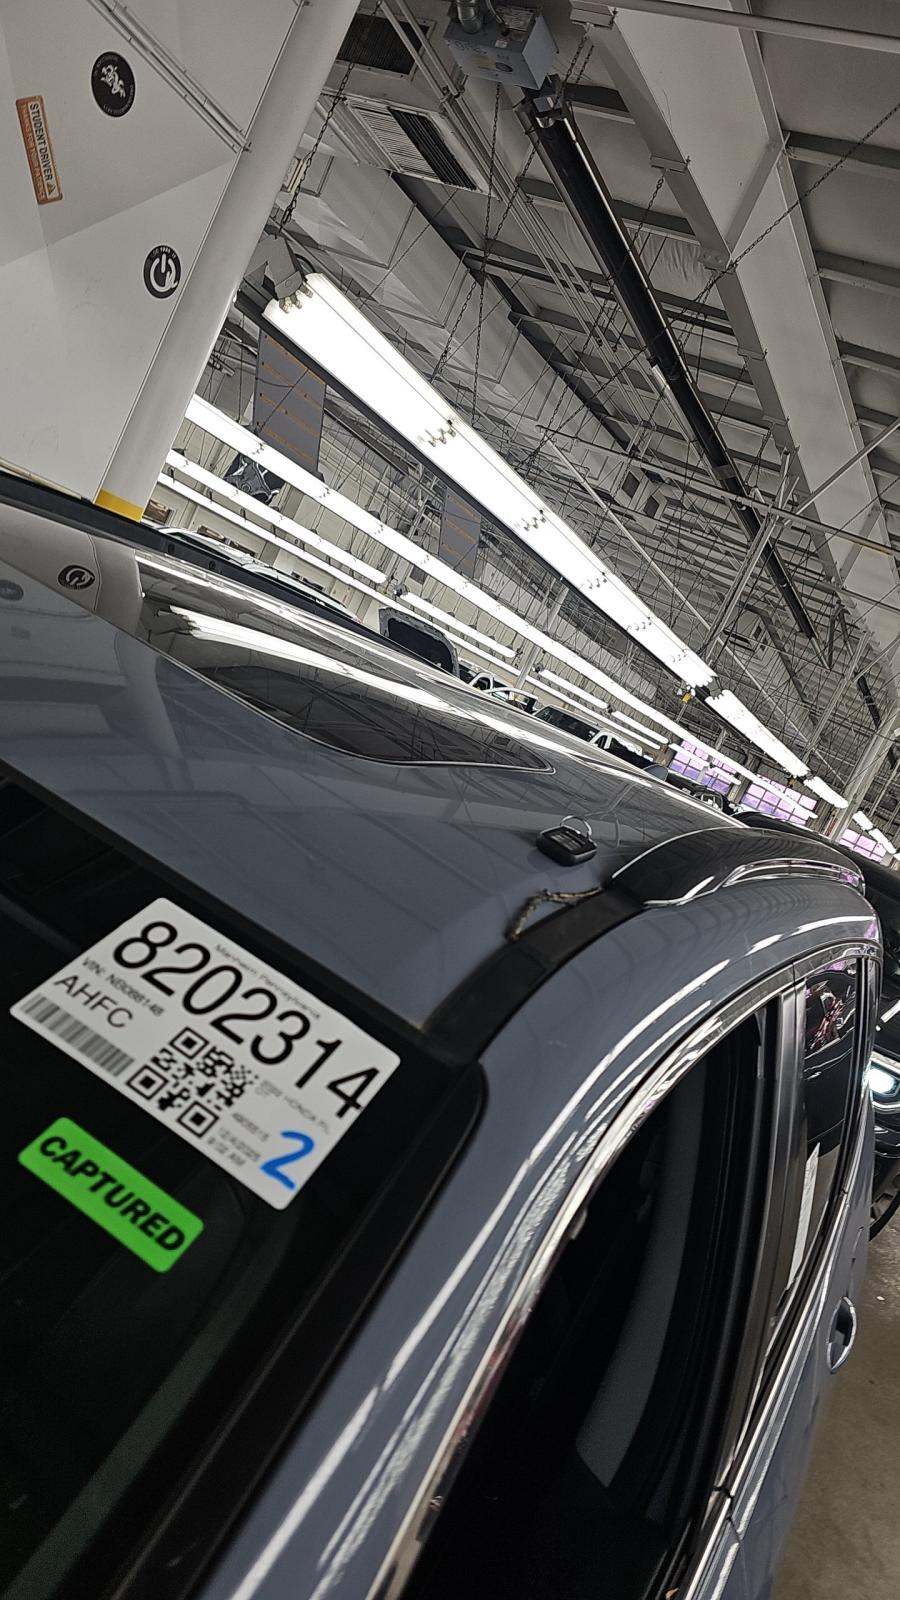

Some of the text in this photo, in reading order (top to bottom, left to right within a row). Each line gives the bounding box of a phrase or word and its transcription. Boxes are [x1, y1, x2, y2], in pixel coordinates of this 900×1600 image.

[30, 102, 53, 181] STUDENT DRIVER
[53, 975, 133, 1028] AHFC
[113, 921, 380, 1118] 8202314
[39, 1135, 186, 1252] CAPTURED
[260, 1130, 315, 1190] 2
